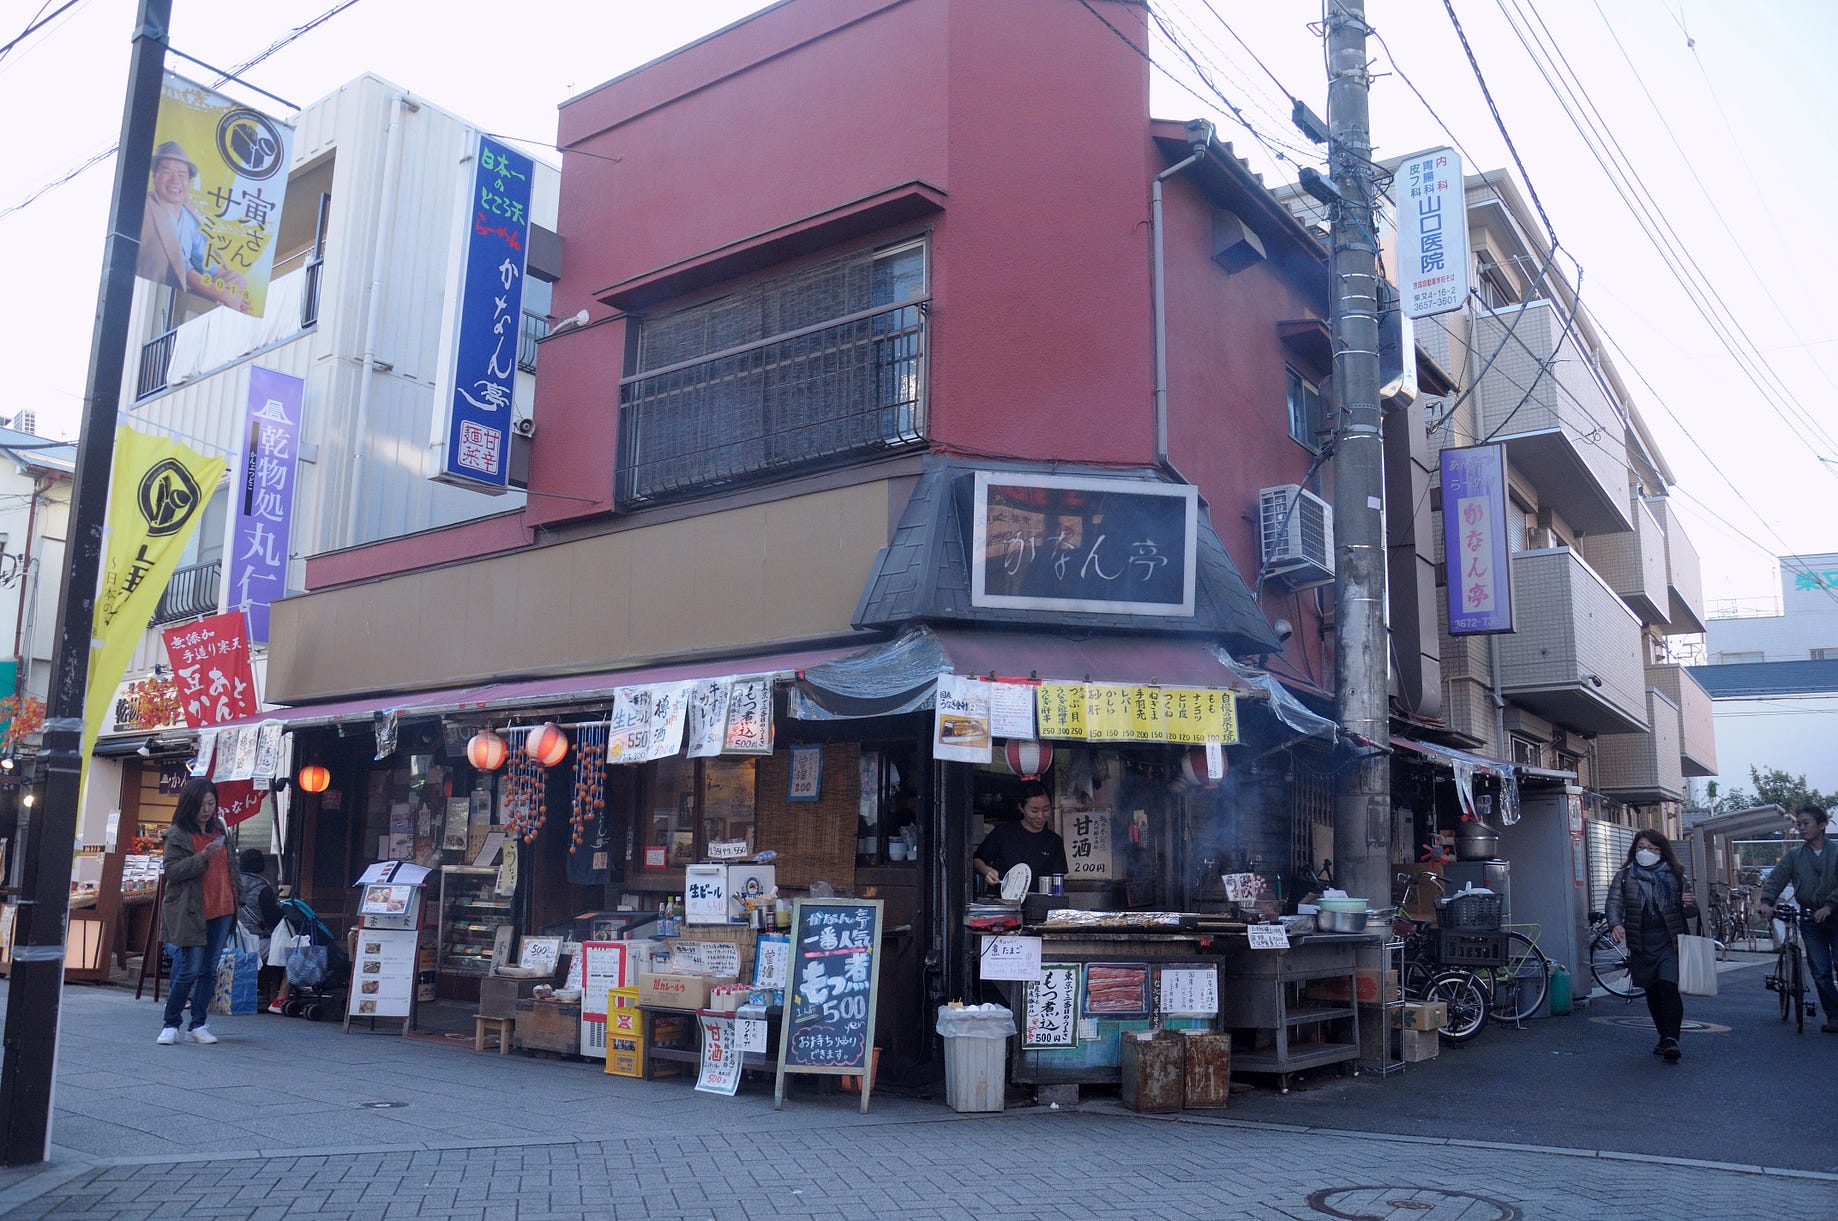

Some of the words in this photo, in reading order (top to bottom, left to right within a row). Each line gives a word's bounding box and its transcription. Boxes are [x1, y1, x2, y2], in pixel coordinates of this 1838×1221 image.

[482, 147, 525, 180] 日本一
[1435, 157, 1449, 193] 内科
[1409, 164, 1422, 198] 皮フ科
[201, 187, 242, 268] サミット
[231, 188, 276, 269] 寅さん
[1418, 195, 1445, 273] 山口医院
[1414, 296, 1457, 311] 3657-3601
[170, 629, 215, 649] 無添加
[182, 636, 242, 663] 手造り寒天
[628, 731, 648, 748] 550
[1072, 815, 1093, 858] 甘酒
[1074, 863, 1105, 872] 200円
[690, 884, 722, 899] 生ビール
[804, 926, 872, 950] 一番人気
[800, 952, 870, 1005] もつ煮
[822, 995, 866, 1023] 500
[1039, 971, 1060, 1031] もつ煮込
[705, 1021, 723, 1061] 甘酒
[798, 1034, 857, 1049] お持ち帰り
[844, 1022, 866, 1034] yen
[1035, 1033, 1061, 1043] 500円
